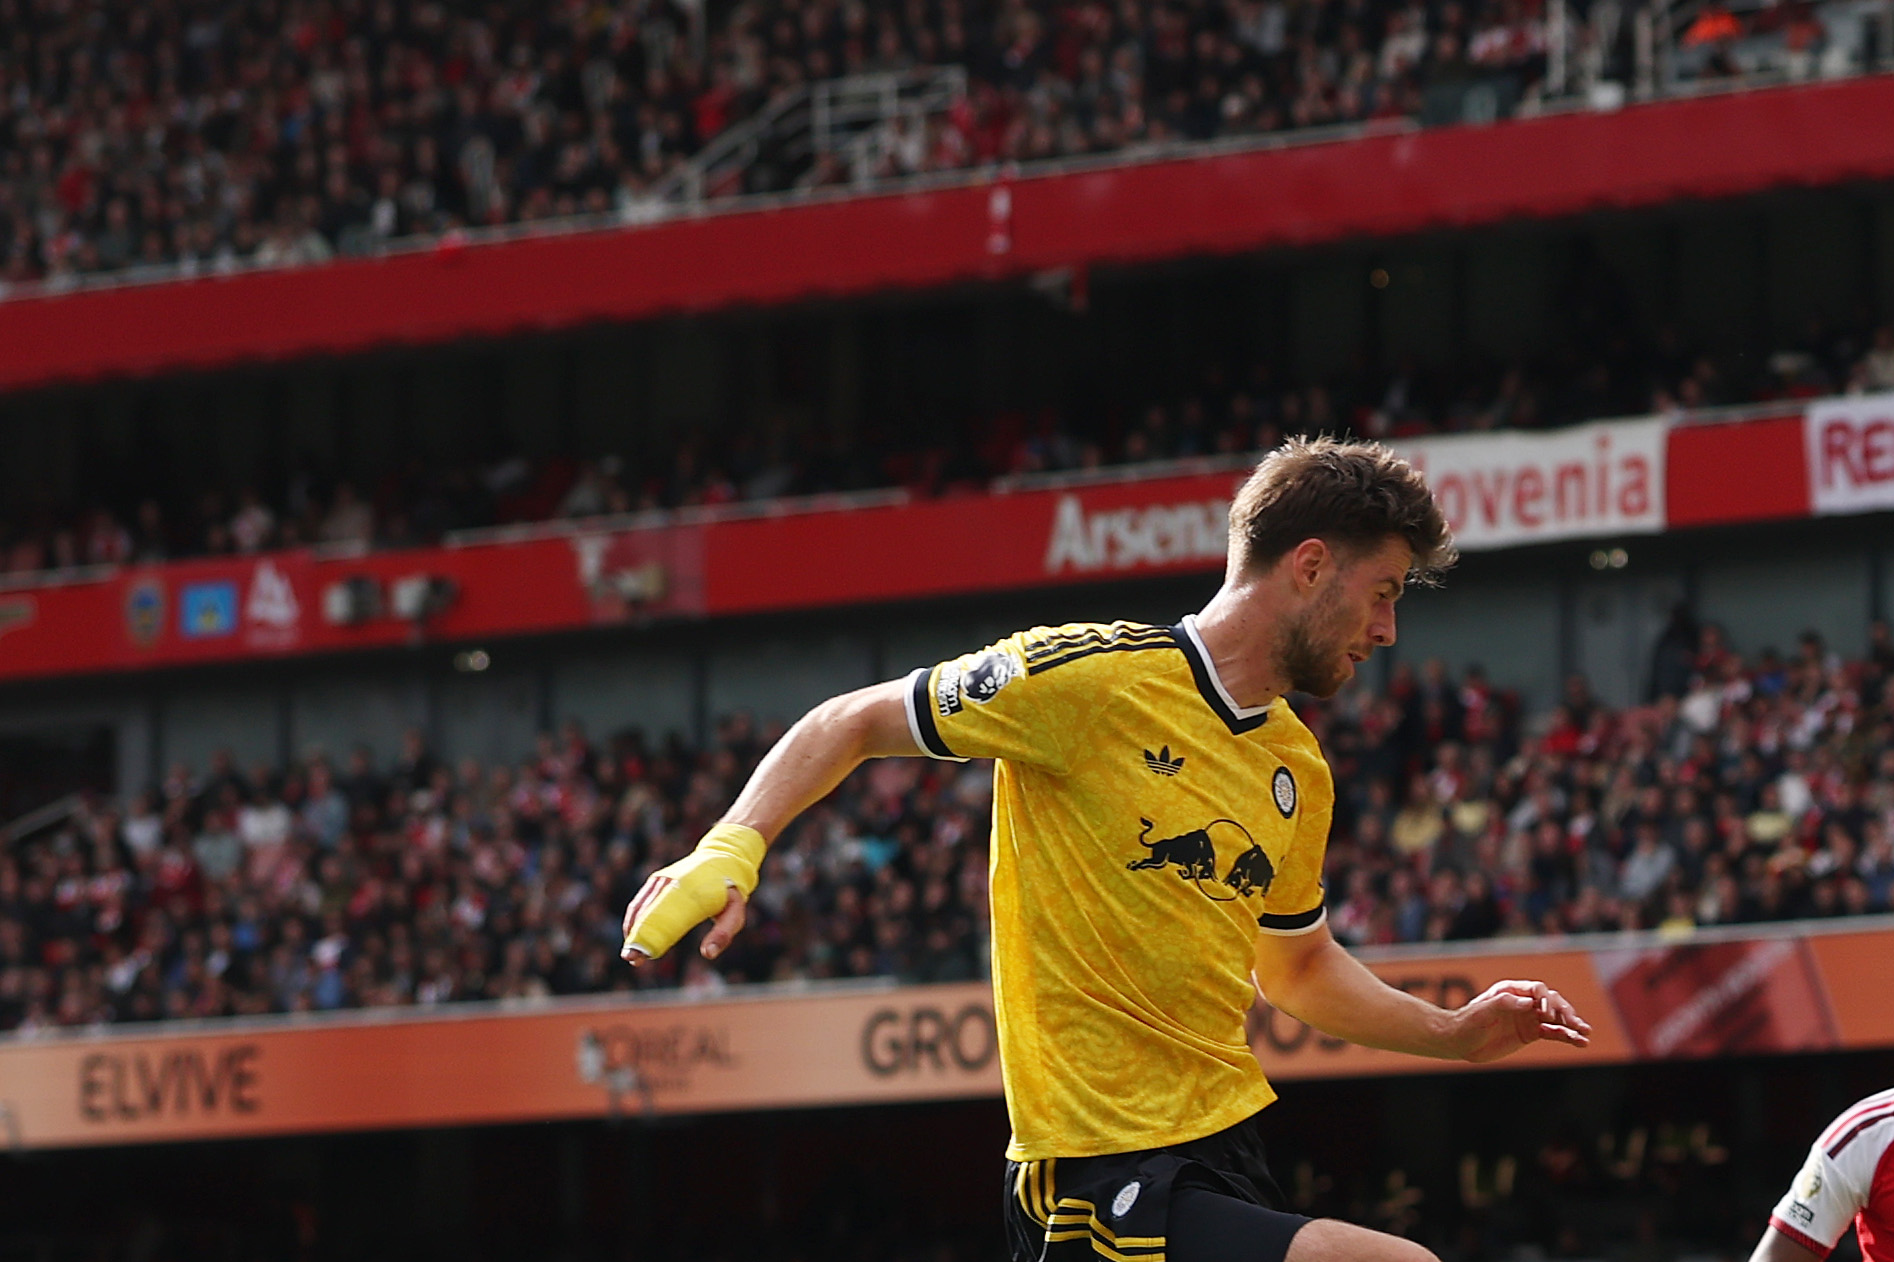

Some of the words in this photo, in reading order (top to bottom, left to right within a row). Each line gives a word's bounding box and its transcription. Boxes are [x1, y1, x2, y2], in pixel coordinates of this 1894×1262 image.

[1411, 434, 1648, 533] ovenia
[1045, 495, 1229, 574] Arsena
[862, 1003, 998, 1076] GRO
[78, 1046, 259, 1122] ELVIVE
